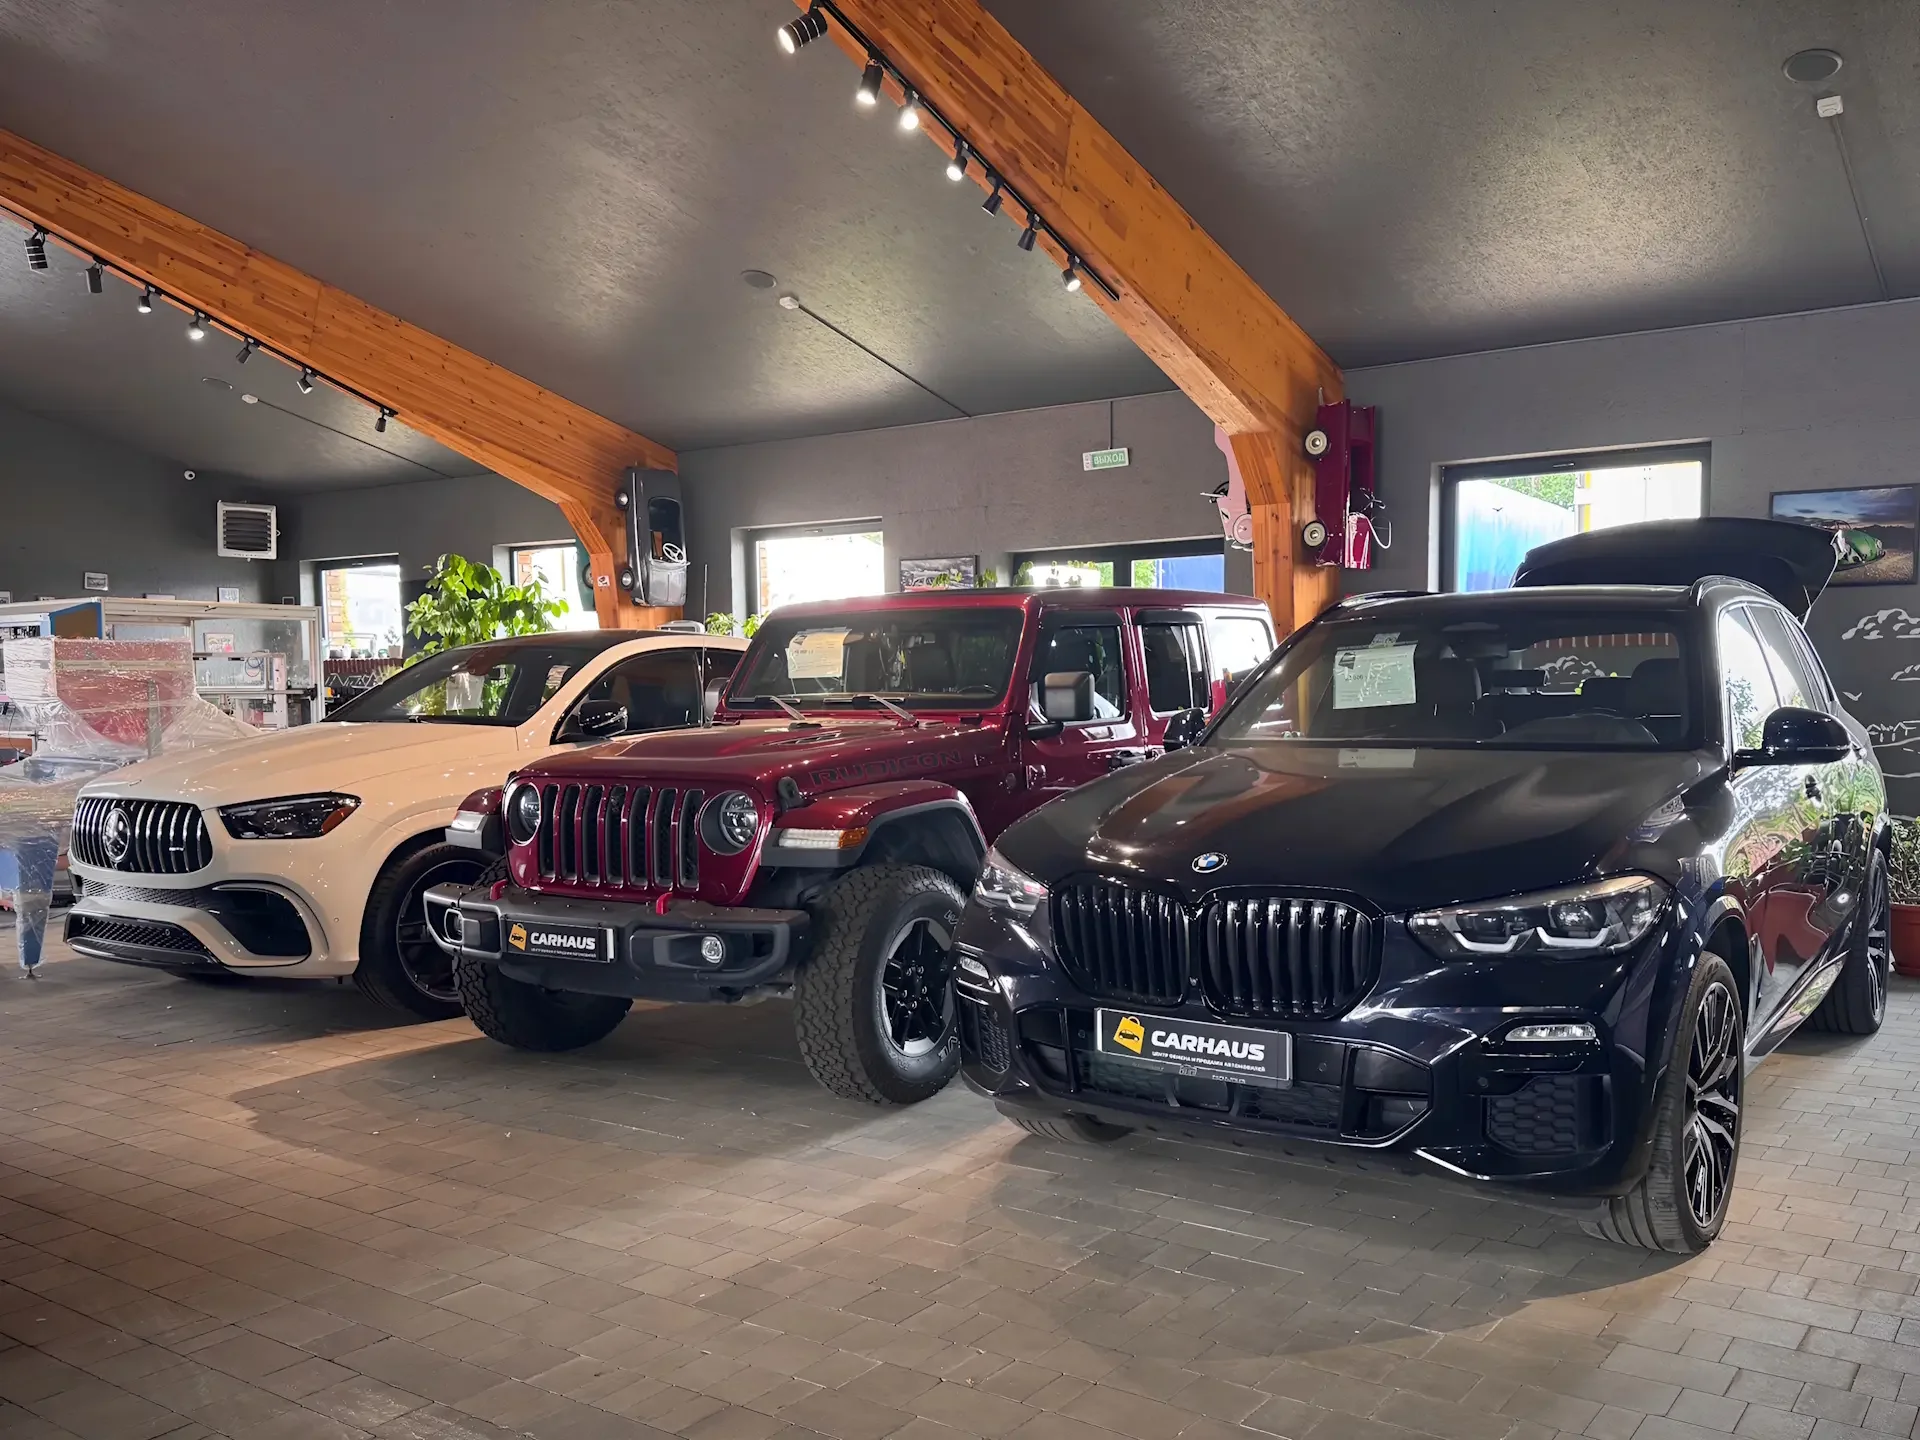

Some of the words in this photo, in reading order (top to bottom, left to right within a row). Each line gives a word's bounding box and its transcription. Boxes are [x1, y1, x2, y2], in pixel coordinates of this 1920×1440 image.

[1093, 452, 1125, 465] ВЫХОД
[808, 751, 963, 788] RUBICON
[530, 932, 596, 950] CARHAUS
[1151, 1030, 1265, 1062] CARHAUS
